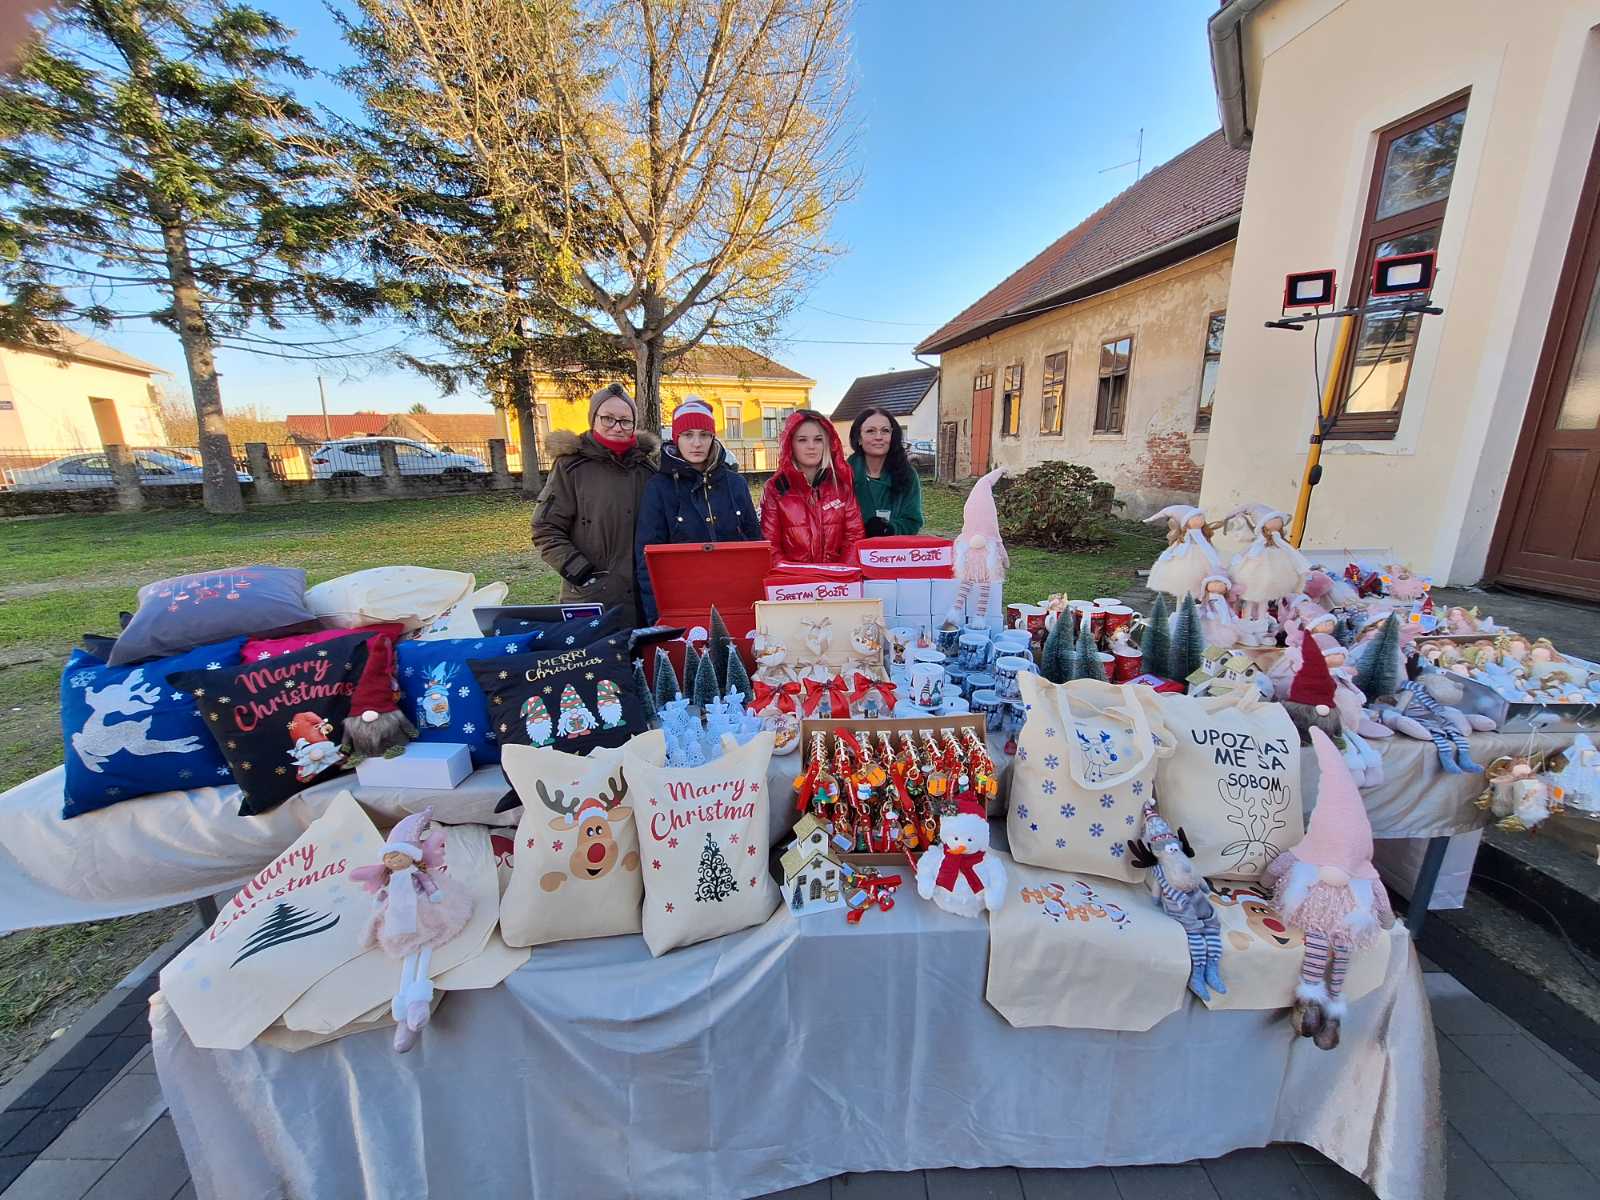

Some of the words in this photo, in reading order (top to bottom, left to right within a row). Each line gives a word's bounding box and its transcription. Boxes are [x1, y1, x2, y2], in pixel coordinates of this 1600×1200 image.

[525, 657, 604, 682] Christmas
[537, 649, 587, 667] MERRY
[234, 659, 333, 694] Marry
[233, 681, 354, 732] Christmas
[1214, 747, 1247, 768] ME
[664, 779, 745, 802] Marry
[1227, 773, 1282, 792] SOBOM
